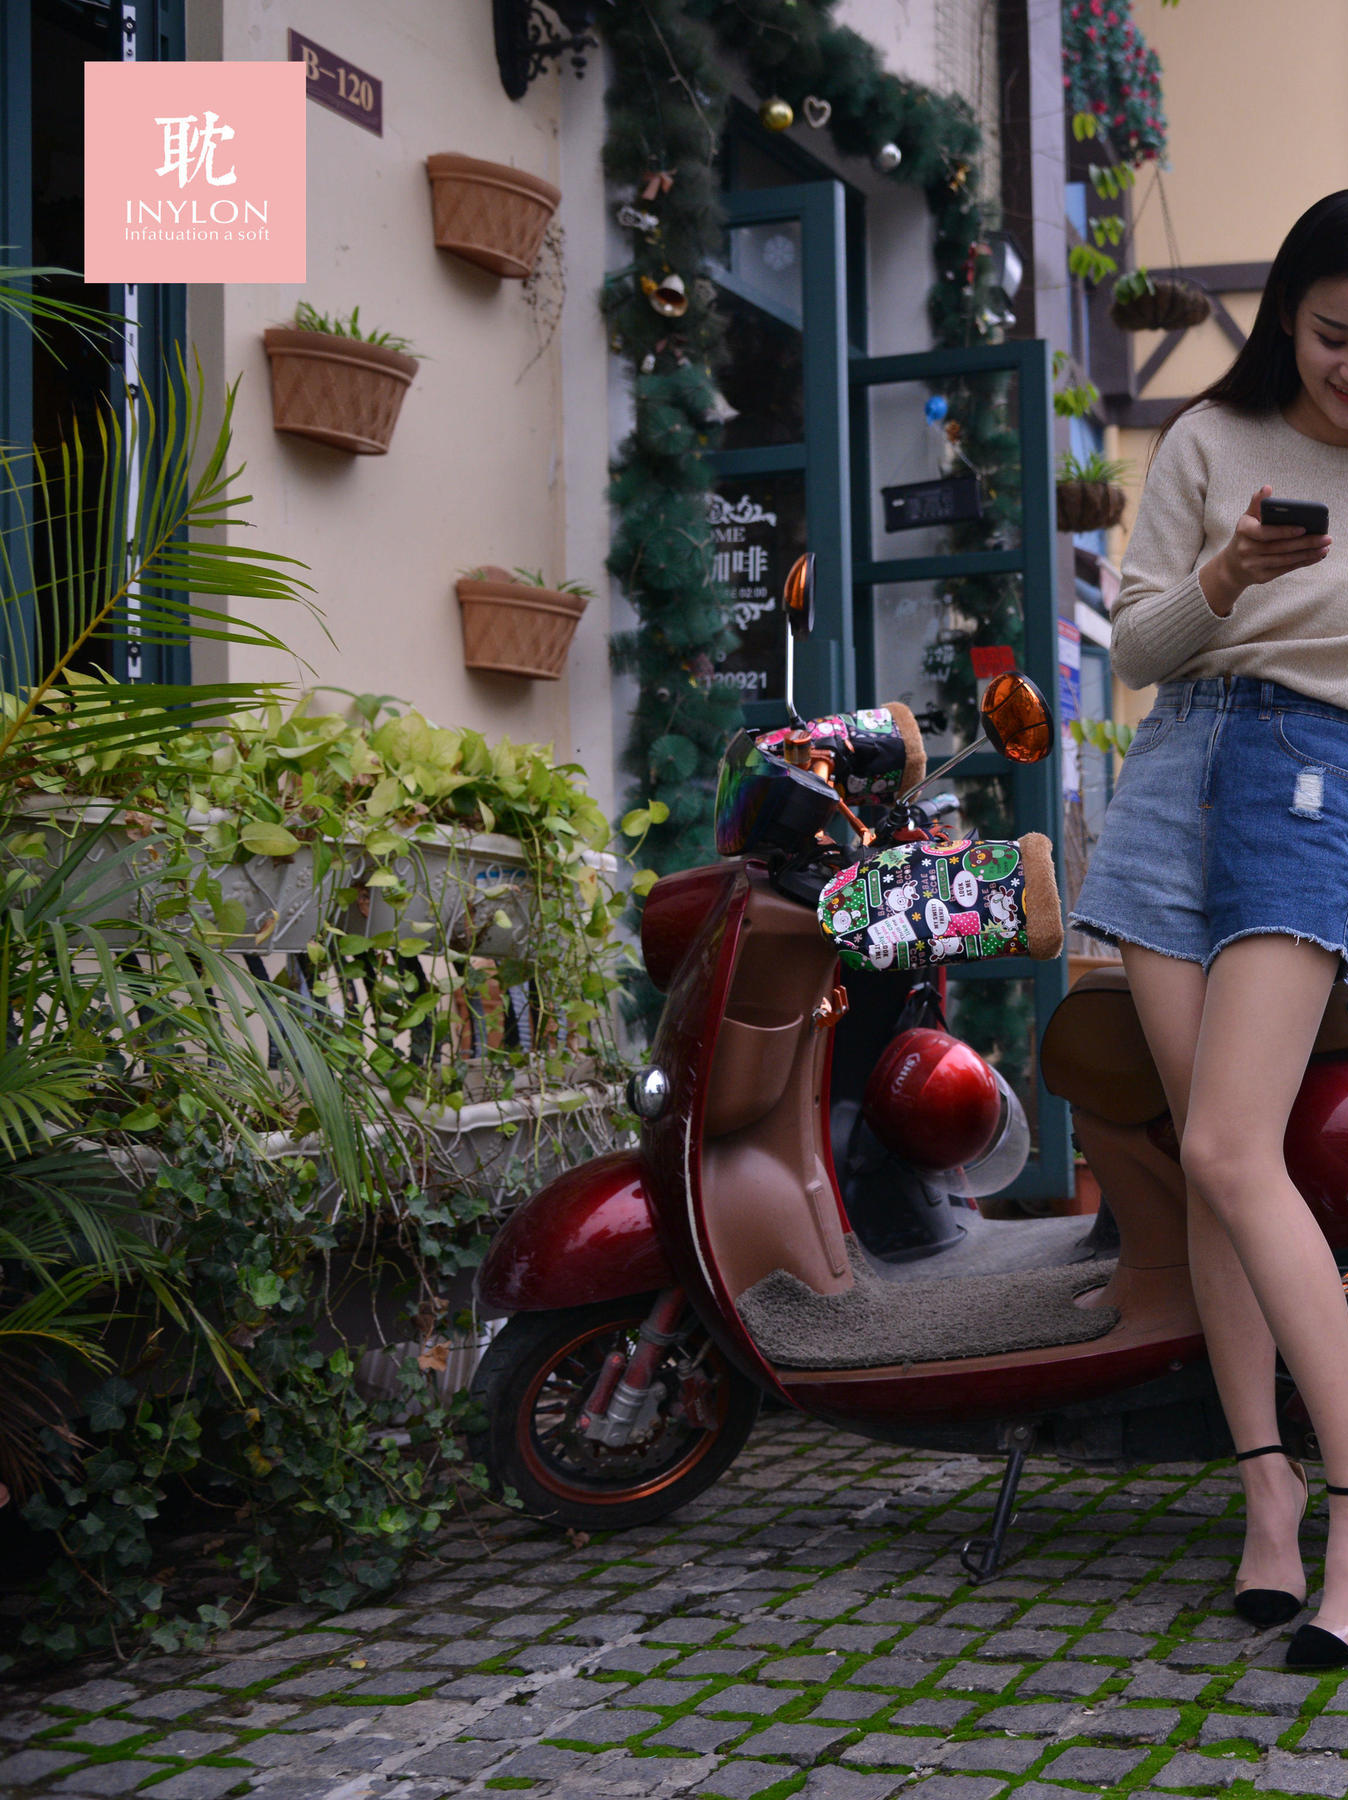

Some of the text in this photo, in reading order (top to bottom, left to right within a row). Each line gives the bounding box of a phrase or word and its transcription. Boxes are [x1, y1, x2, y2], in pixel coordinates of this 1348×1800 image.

[302, 46, 374, 112] B-120
[920, 873, 929, 889] BAE
[965, 880, 971, 888] ME
[934, 921, 939, 929] MY
